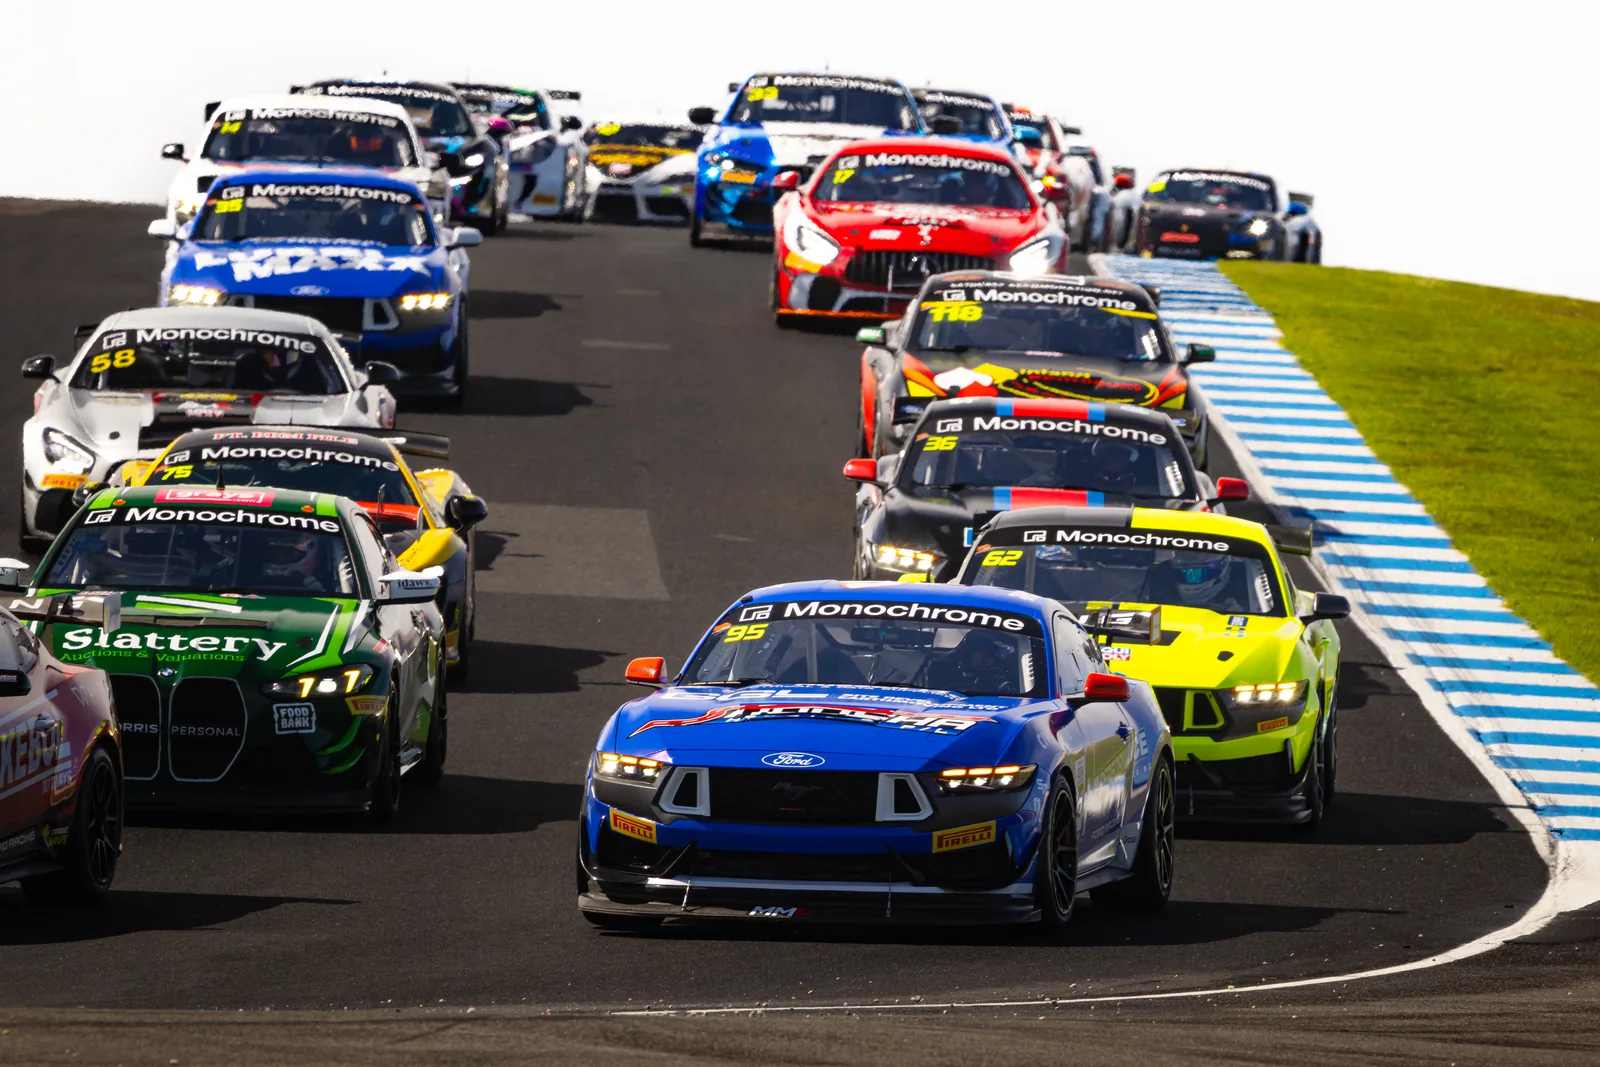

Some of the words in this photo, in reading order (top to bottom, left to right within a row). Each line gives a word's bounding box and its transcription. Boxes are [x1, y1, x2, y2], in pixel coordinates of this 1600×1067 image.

[252, 108, 398, 127] Monochrome
[865, 153, 1011, 177] Monochrome
[833, 170, 855, 184] 17
[252, 184, 411, 204] Monochrome
[974, 289, 1137, 311] Monochrome
[137, 328, 316, 353] Monochrome
[91, 348, 136, 374] 58
[974, 416, 1167, 446] Monochrome
[922, 436, 959, 452] 36
[201, 446, 400, 472] Monochrome
[159, 464, 194, 481] 75
[176, 491, 255, 500] grays
[124, 507, 339, 533] Monochrome
[1056, 530, 1230, 552] Monochrome
[982, 550, 1024, 567] 62
[784, 601, 1025, 631] Monochrome
[724, 623, 769, 644] 95
[62, 627, 286, 662] Slattery
[60, 648, 133, 663] Auctions
[136, 650, 149, 660] &
[156, 652, 245, 663] Valuations
[280, 706, 309, 718] FOOD
[171, 726, 241, 737] PERSONAL
[281, 717, 310, 729] BANK
[773, 754, 814, 766] Ford
[613, 812, 653, 840] PIRELLI
[937, 825, 992, 849] PIRELLI
